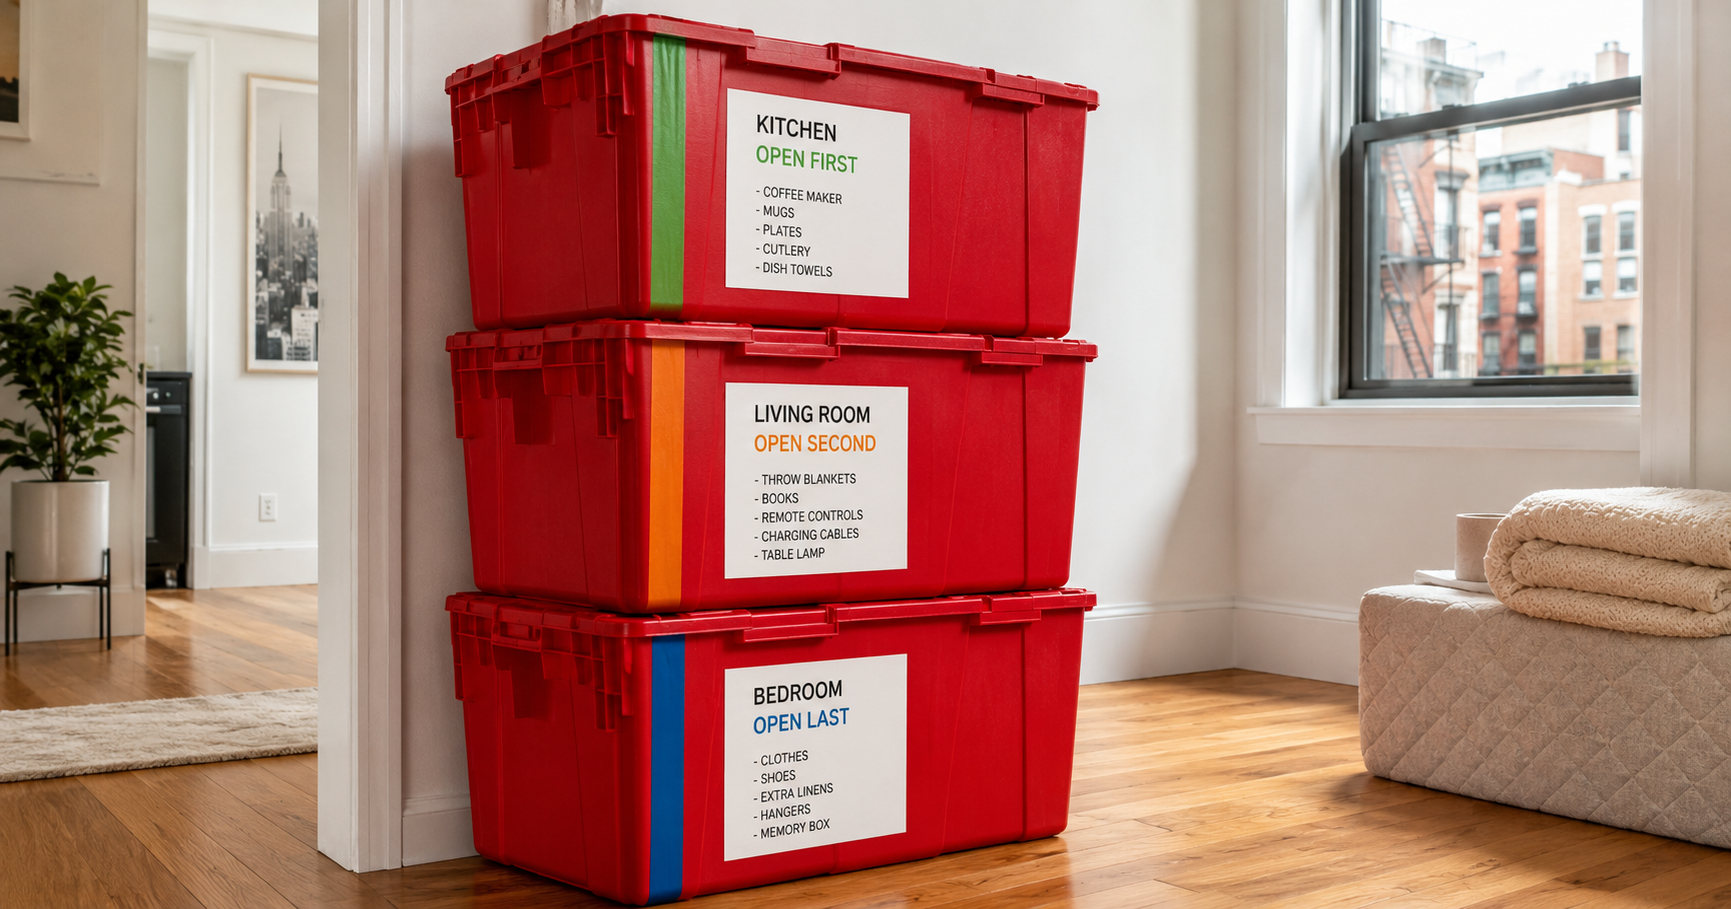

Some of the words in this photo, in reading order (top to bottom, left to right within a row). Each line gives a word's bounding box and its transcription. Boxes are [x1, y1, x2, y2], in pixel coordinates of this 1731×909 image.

[757, 114, 836, 142] KITCHEN
[756, 145, 804, 168] OPEN
[811, 152, 858, 173] FIRST
[763, 186, 803, 200] COFFEE
[807, 191, 842, 204] MAKER
[764, 205, 794, 218] MUGS
[763, 224, 802, 238] PLATES
[763, 243, 811, 257] CUTLERY
[763, 262, 787, 274] DISH
[790, 264, 832, 277] TOWELS
[755, 405, 813, 423] LIVING
[819, 406, 870, 423] ROOM
[754, 434, 801, 452] OPEN
[807, 434, 876, 452] SECOND
[762, 474, 801, 485] THROW
[804, 473, 856, 484] BLANKETS
[762, 493, 799, 504] BOOKS
[762, 511, 805, 523] REMOTE
[808, 509, 863, 522] CONTROLS
[762, 529, 817, 542] CHARGING
[820, 528, 859, 540] CABLES
[761, 549, 794, 560] TABLE
[797, 547, 825, 559] LAMP
[754, 680, 842, 705] BEDROOM
[754, 713, 801, 734] OPEN
[808, 707, 849, 728] LAST
[761, 750, 808, 766] CLOTHES
[761, 770, 796, 784] SHOES
[761, 788, 794, 802] EXTRA
[798, 783, 833, 797] LINENS
[761, 803, 811, 821] HANGERS
[761, 822, 806, 839] MEMORY
[809, 818, 830, 831] BOX
